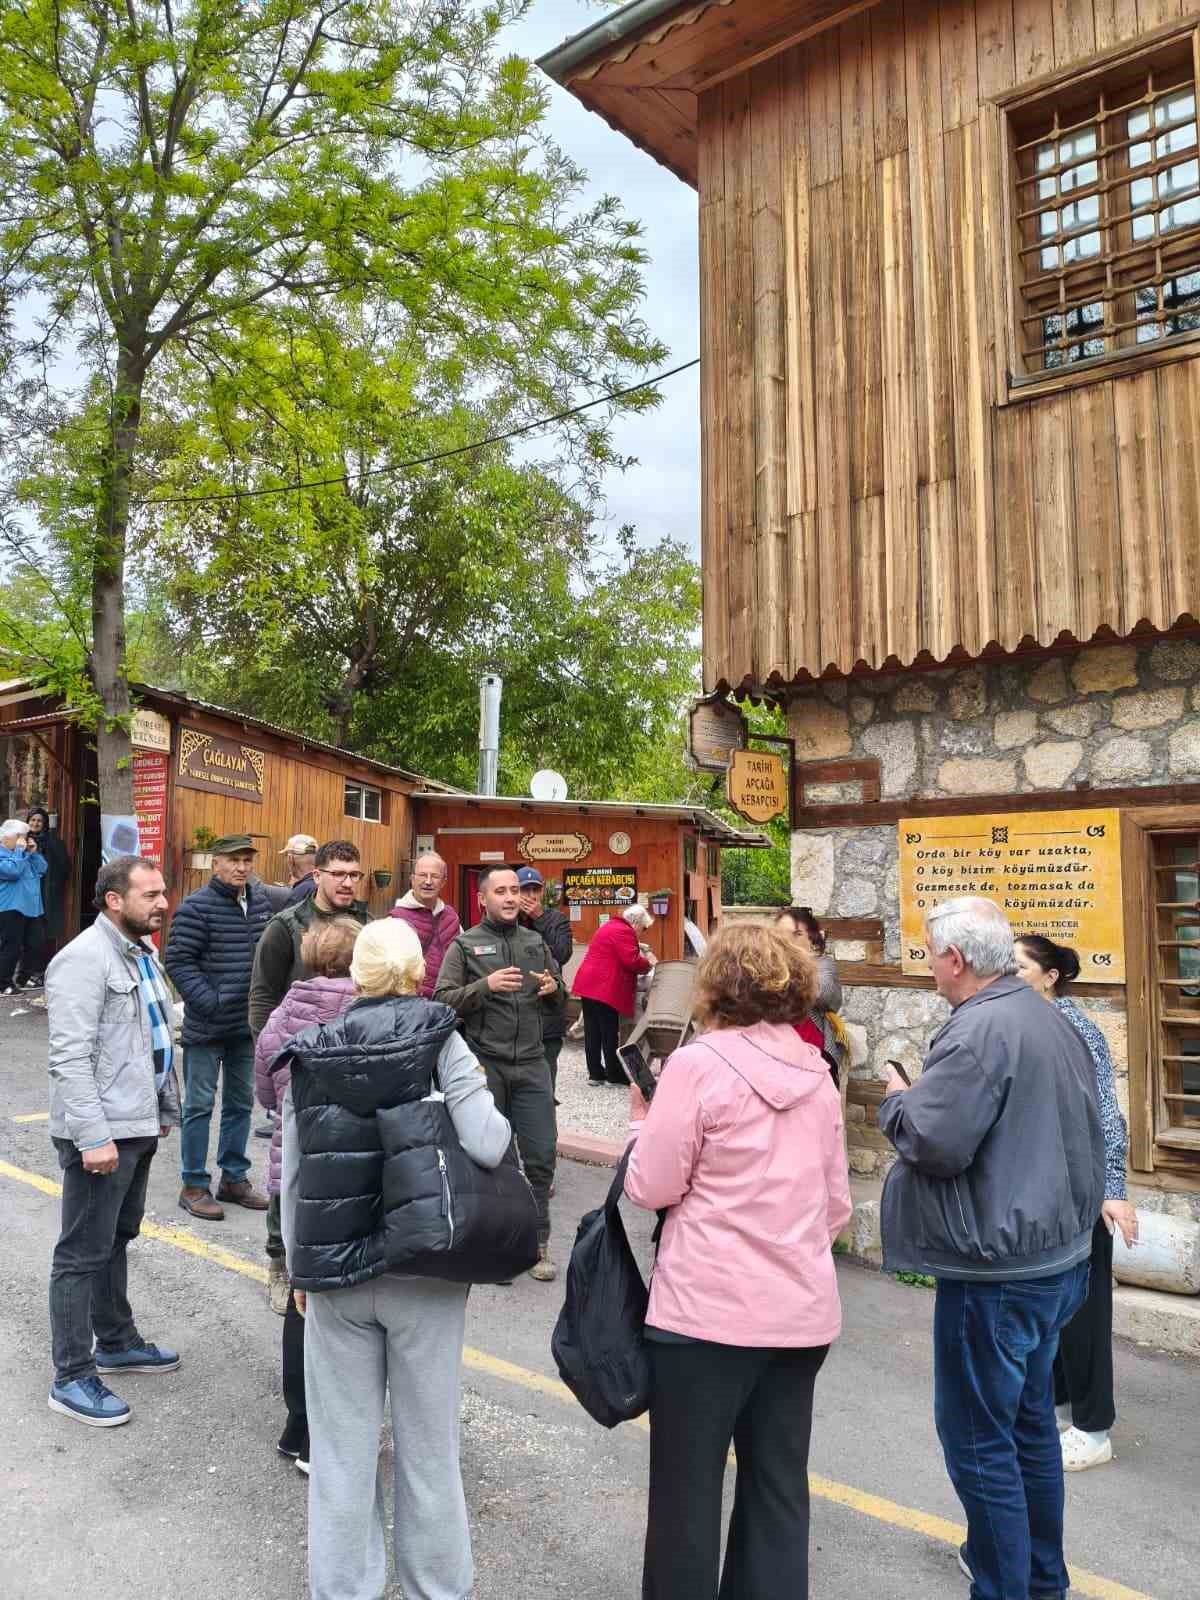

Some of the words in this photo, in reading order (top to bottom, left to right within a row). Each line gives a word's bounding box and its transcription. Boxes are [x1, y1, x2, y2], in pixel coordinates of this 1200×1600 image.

[203, 748, 247, 772] ÇAĞLAYAN
[746, 759, 773, 774] TARİHİ
[745, 777, 775, 791] APÇAĞA
[741, 794, 779, 808] KEBAPÇISI
[916, 849, 945, 859] Orda
[953, 848, 971, 858] bir
[979, 847, 1001, 860] köy
[1009, 847, 1031, 857] var
[1038, 845, 1092, 857] uzakta,
[916, 866, 925, 875] O
[932, 865, 953, 877] köy
[960, 864, 995, 875] bizim
[1003, 862, 1092, 876] köyümüzdür.
[916, 882, 976, 892] Gezmesek
[980, 882, 999, 893] de,
[1007, 881, 1073, 891] tozmasak
[1078, 881, 1095, 890] da
[917, 899, 926, 908] O
[1004, 897, 1095, 910] köyümüzdür.
[1050, 920, 1079, 928] TECER
